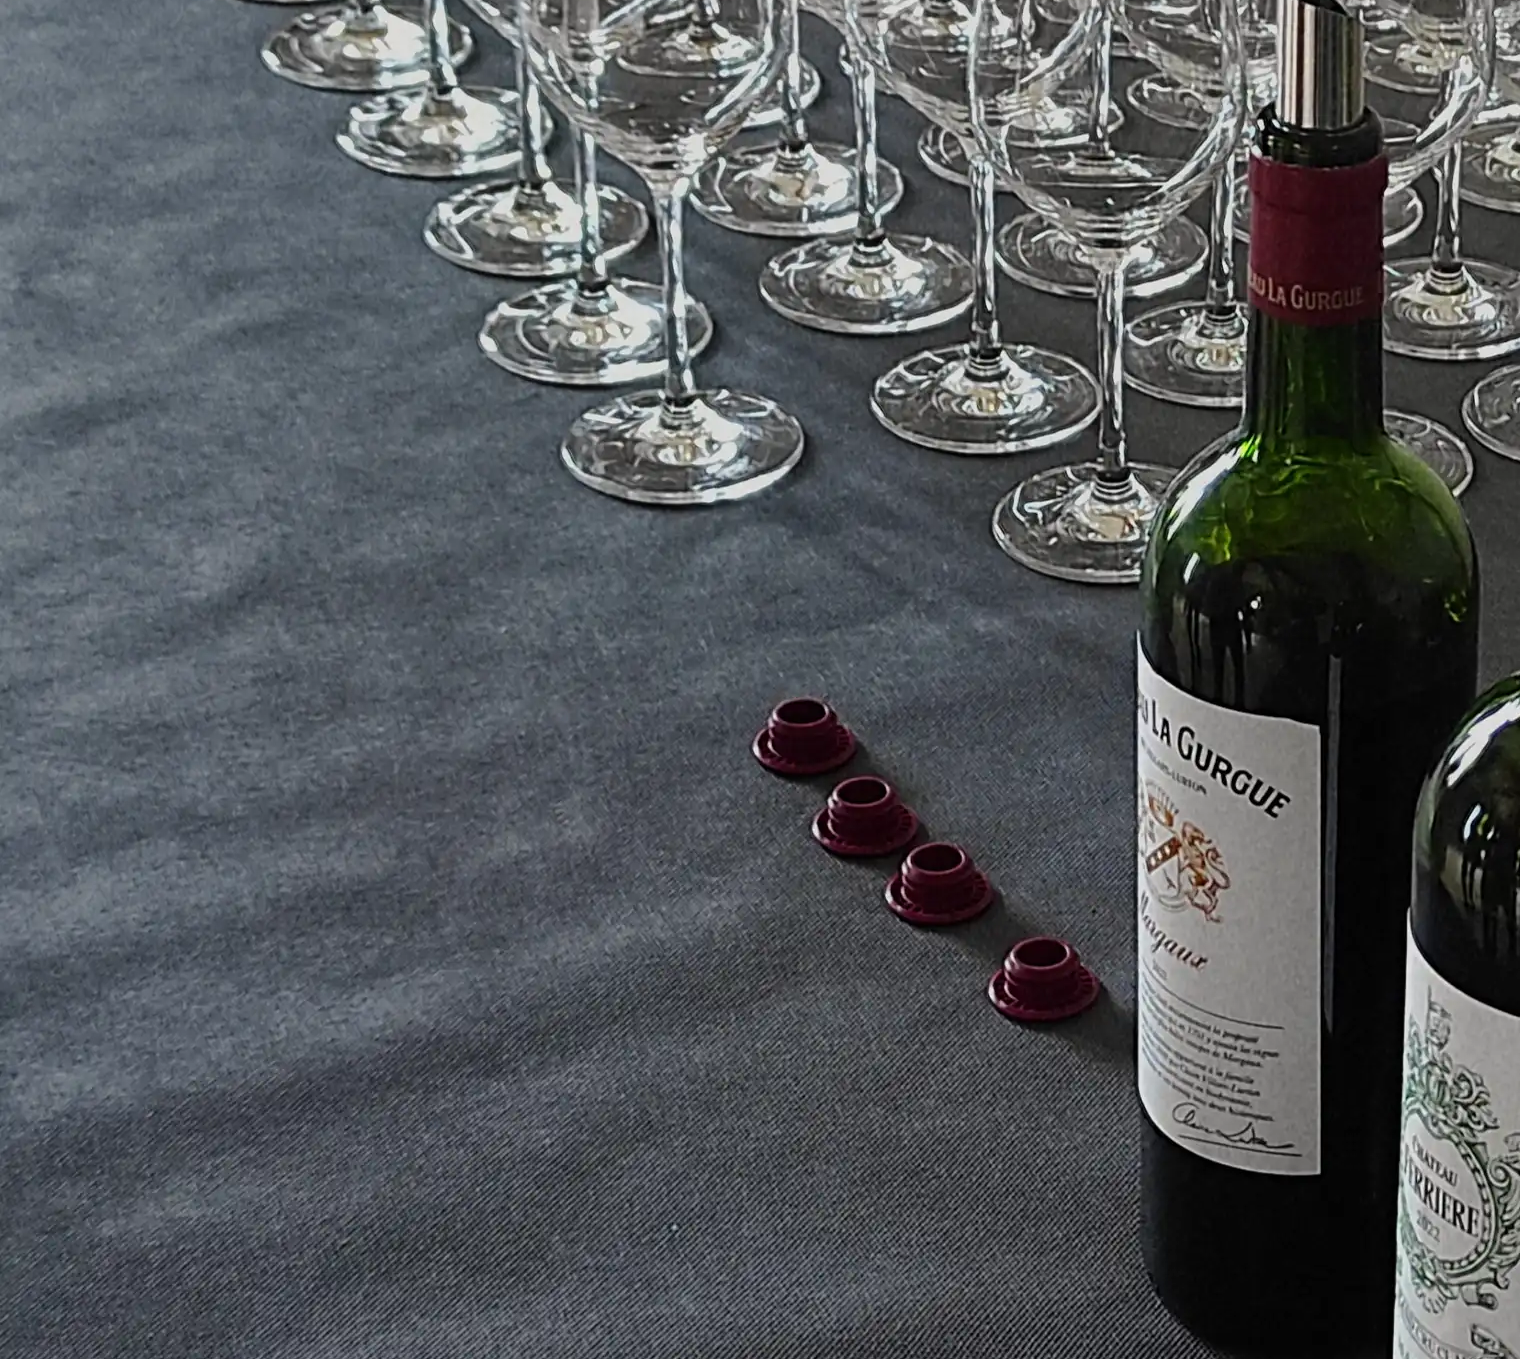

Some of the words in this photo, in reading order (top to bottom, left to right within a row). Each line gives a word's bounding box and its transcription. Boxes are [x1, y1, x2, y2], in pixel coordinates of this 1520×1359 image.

[1267, 275, 1287, 308] LA
[1290, 283, 1365, 311] GURGUE
[1152, 698, 1172, 748] LA
[1177, 725, 1291, 819] GURGUE
